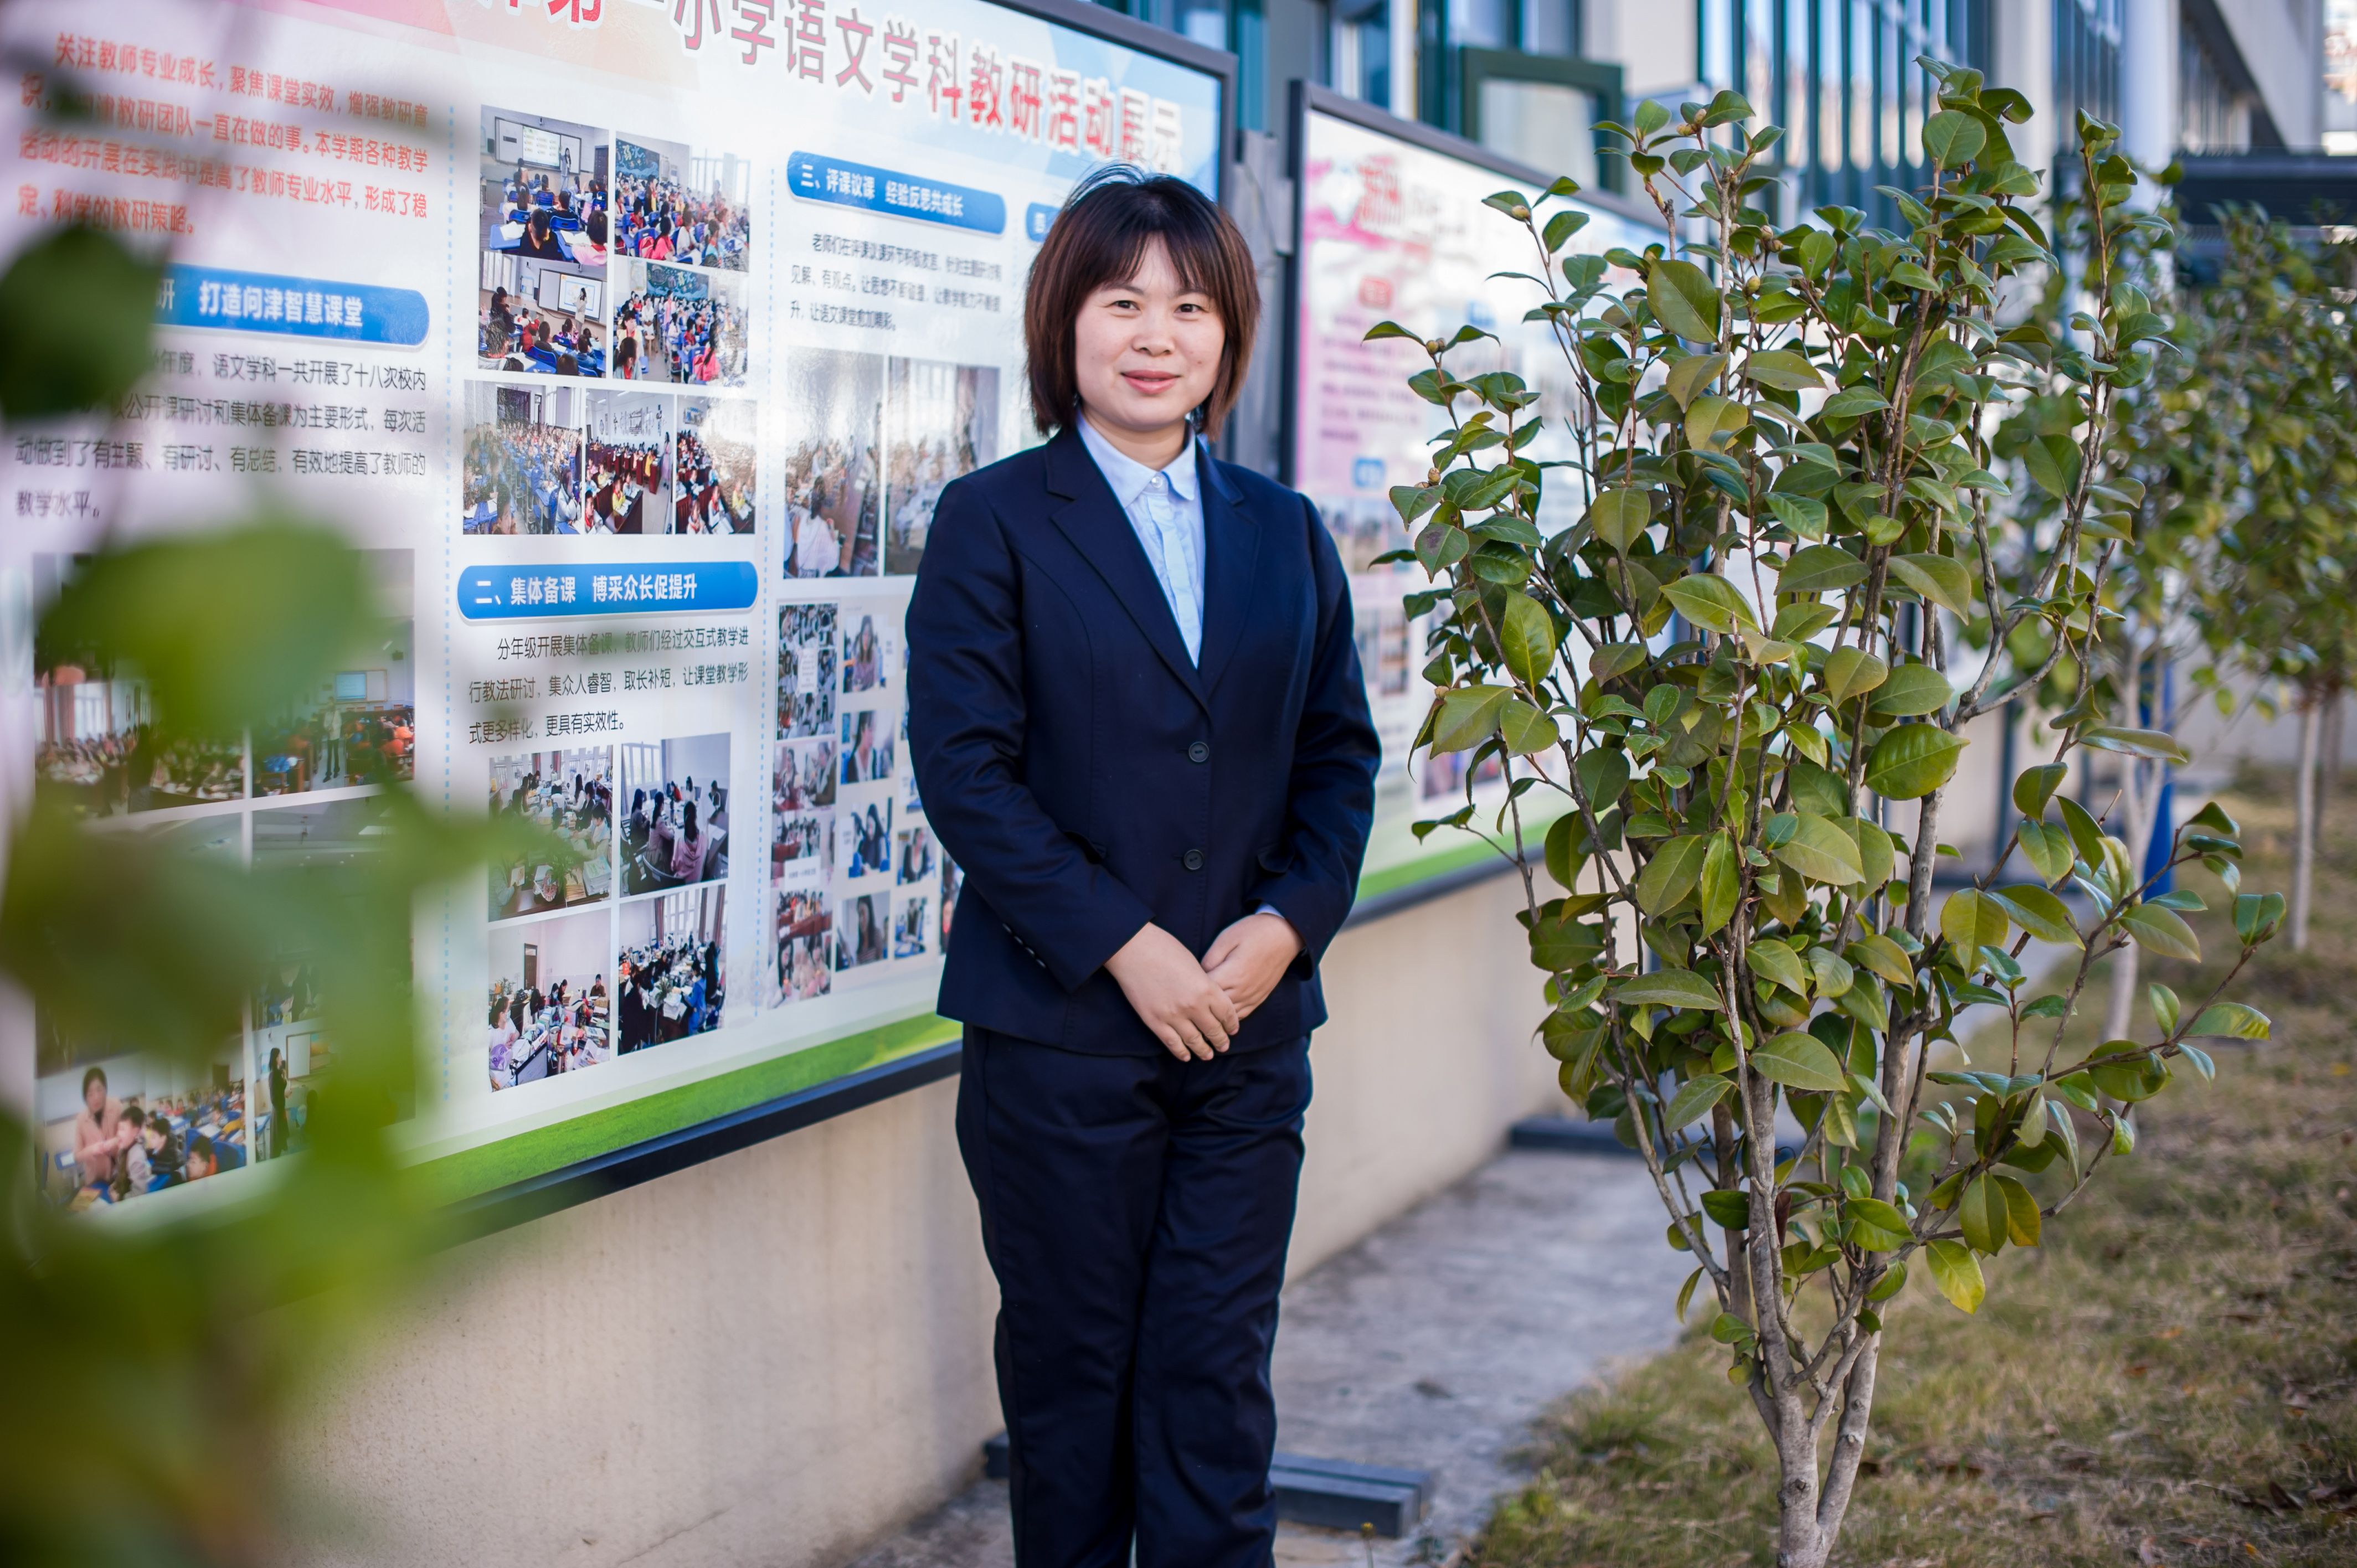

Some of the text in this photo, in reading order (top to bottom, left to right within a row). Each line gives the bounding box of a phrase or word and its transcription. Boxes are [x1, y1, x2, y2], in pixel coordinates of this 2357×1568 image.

[508, 0, 1176, 171] 小学语文学科教研活动展示
[199, 280, 363, 327] 打造问津智慧课堂
[475, 572, 698, 606] 二、集体备课 博采众长促提升
[469, 709, 625, 744] 式更多样化，更具有实效性。
